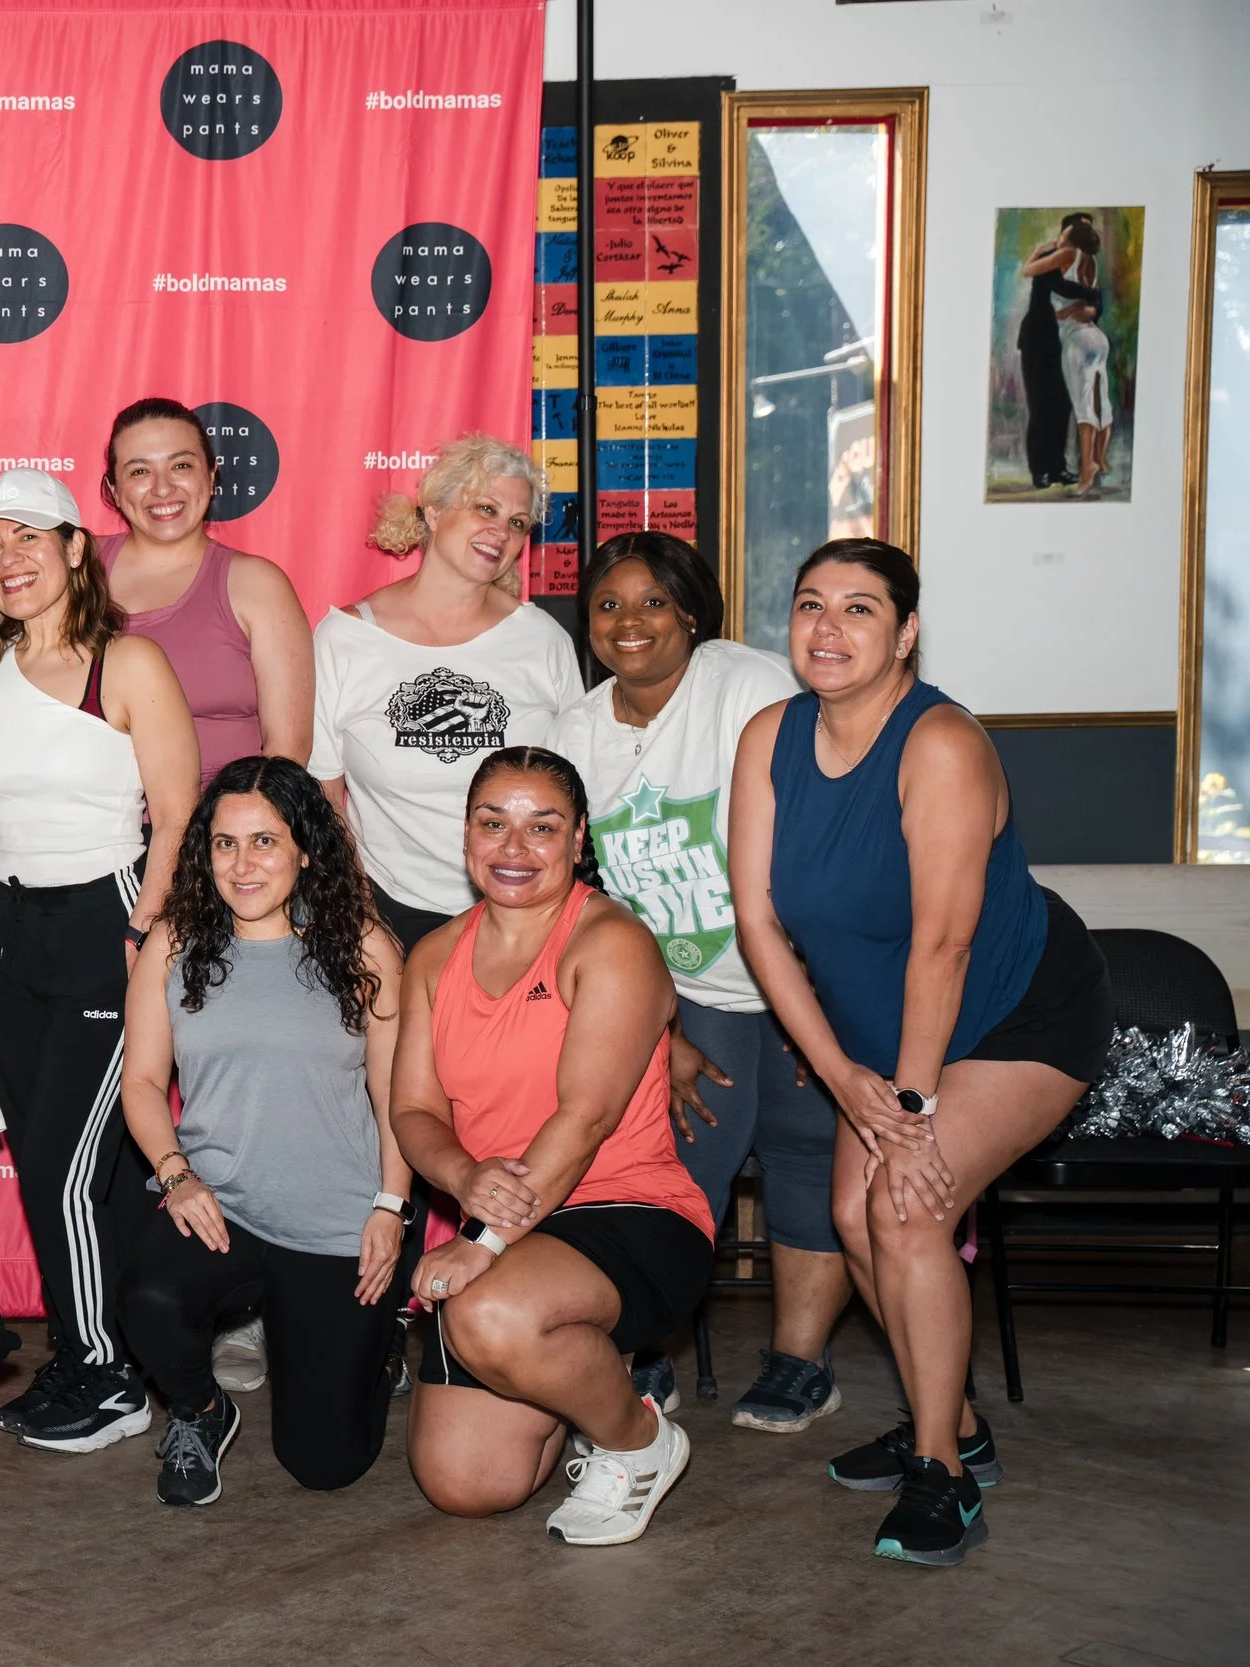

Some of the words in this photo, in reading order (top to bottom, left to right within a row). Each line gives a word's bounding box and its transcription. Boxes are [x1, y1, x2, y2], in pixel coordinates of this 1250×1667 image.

[190, 64, 253, 75] mama
[182, 93, 261, 105] wears
[365, 90, 502, 110] #boldmamas
[183, 122, 259, 138] pants
[653, 128, 689, 140] Oliver
[651, 157, 693, 169] Silvina
[403, 245, 464, 256] mama
[152, 273, 287, 293] #boldmamas
[394, 274, 472, 286] wears
[394, 302, 471, 318] pants
[651, 301, 691, 316] Anna
[206, 425, 250, 437] ama
[215, 455, 257, 466] ars
[363, 450, 439, 470] #boldm
[215, 483, 257, 497] nts
[398, 732, 502, 747] resistencia
[601, 817, 690, 867] KEEP
[597, 844, 722, 896] AUSTIN
[526, 993, 552, 1002] adidas
[82, 1008, 119, 1020] adidas
